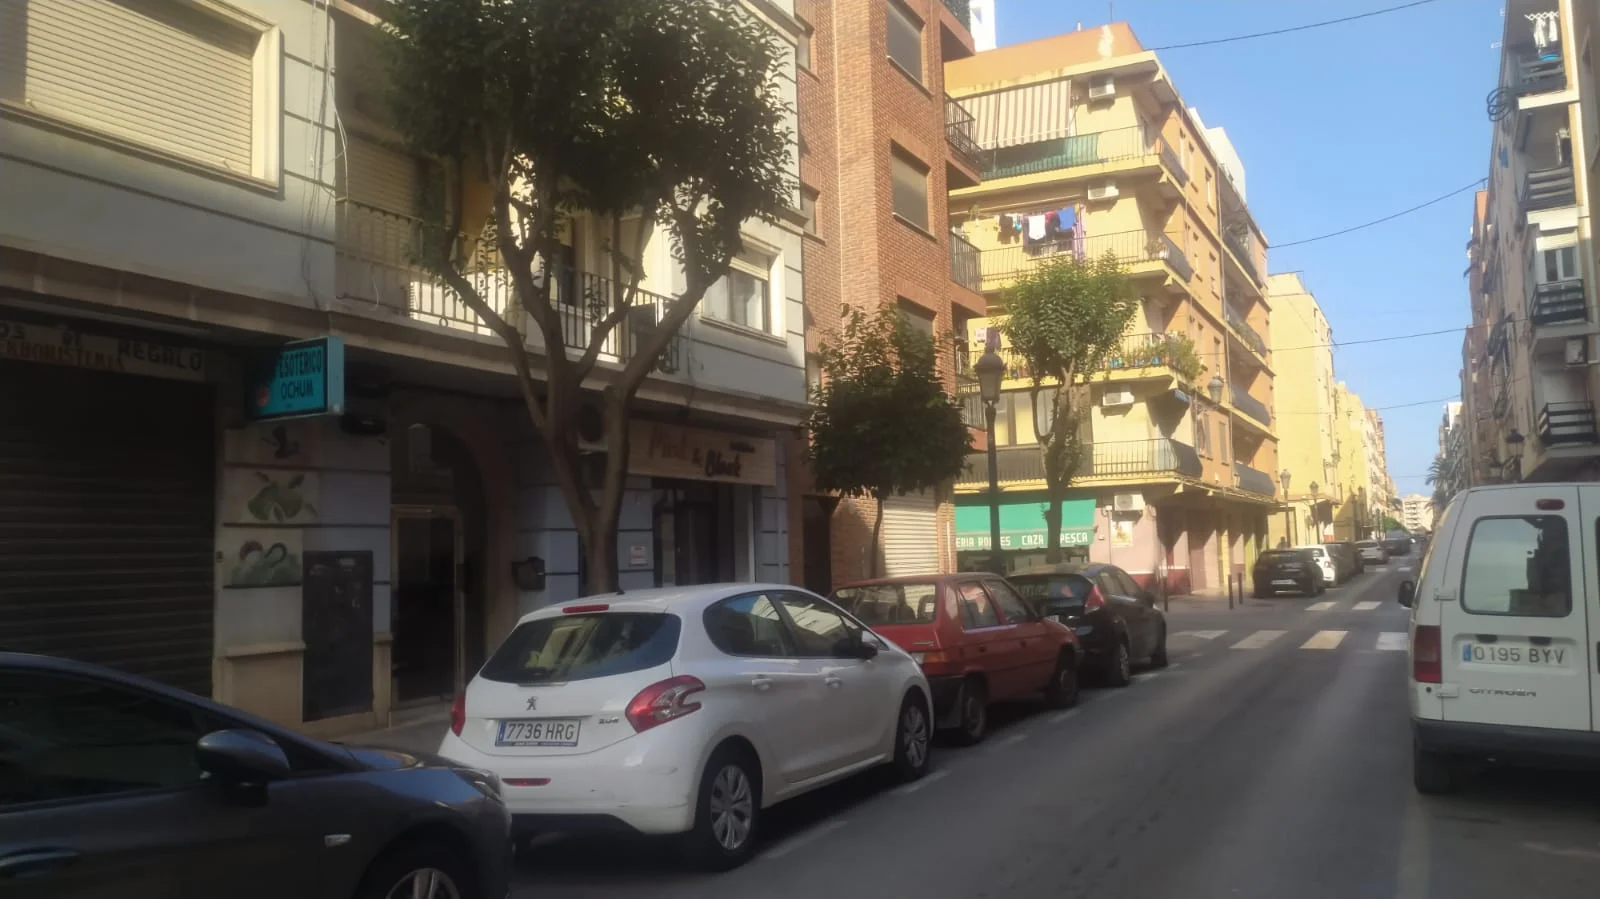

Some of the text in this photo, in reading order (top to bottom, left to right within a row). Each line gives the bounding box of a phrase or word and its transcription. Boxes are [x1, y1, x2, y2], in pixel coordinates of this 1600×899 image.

[117, 340, 203, 371] REGALO
[1021, 534, 1044, 546] CAZA
[1060, 532, 1088, 544] PESCA
[1474, 646, 1564, 664] 0195 BYV
[507, 723, 574, 740] 7736 HRG
